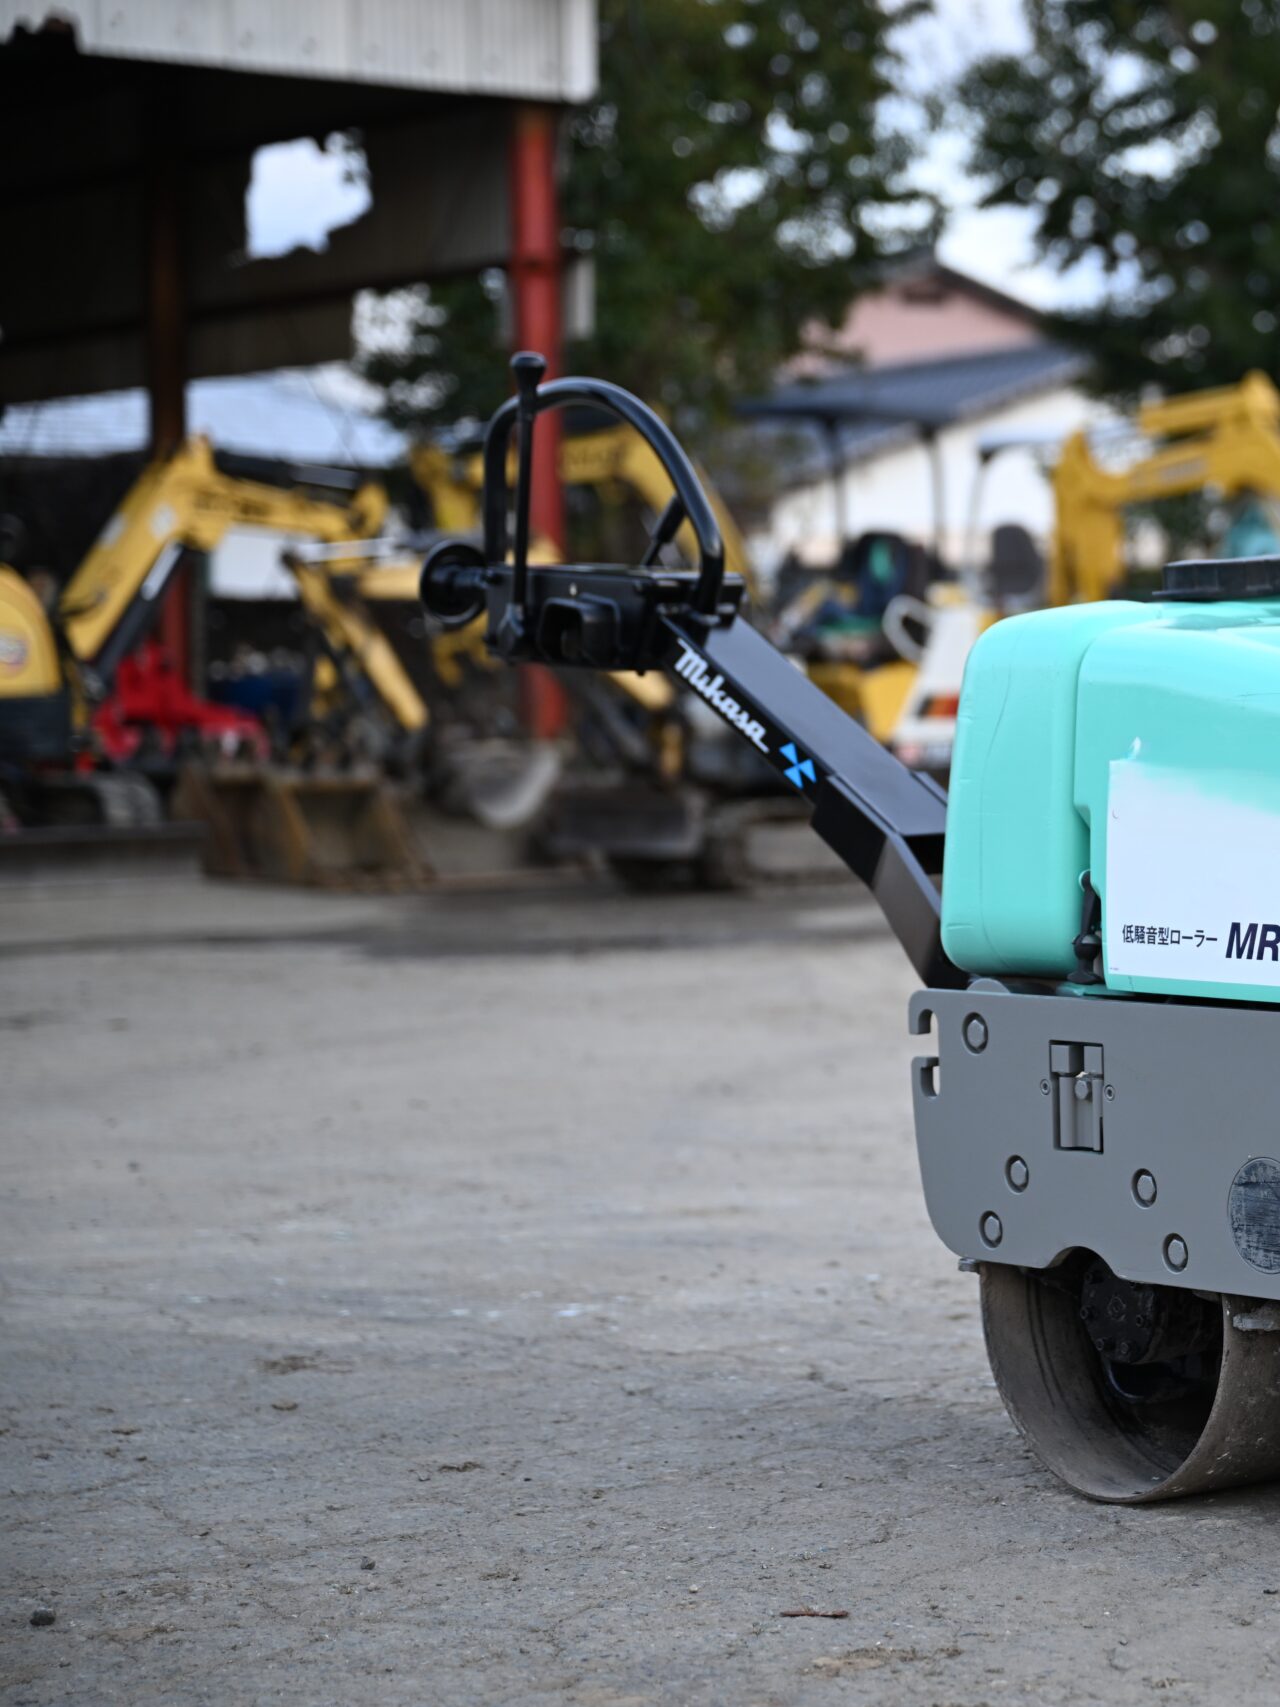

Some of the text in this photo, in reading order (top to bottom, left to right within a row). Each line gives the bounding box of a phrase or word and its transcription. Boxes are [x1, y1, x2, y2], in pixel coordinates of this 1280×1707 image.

[674, 638, 770, 753] Mikasa
[1122, 923, 1218, 948] 低騒音型ローラー
